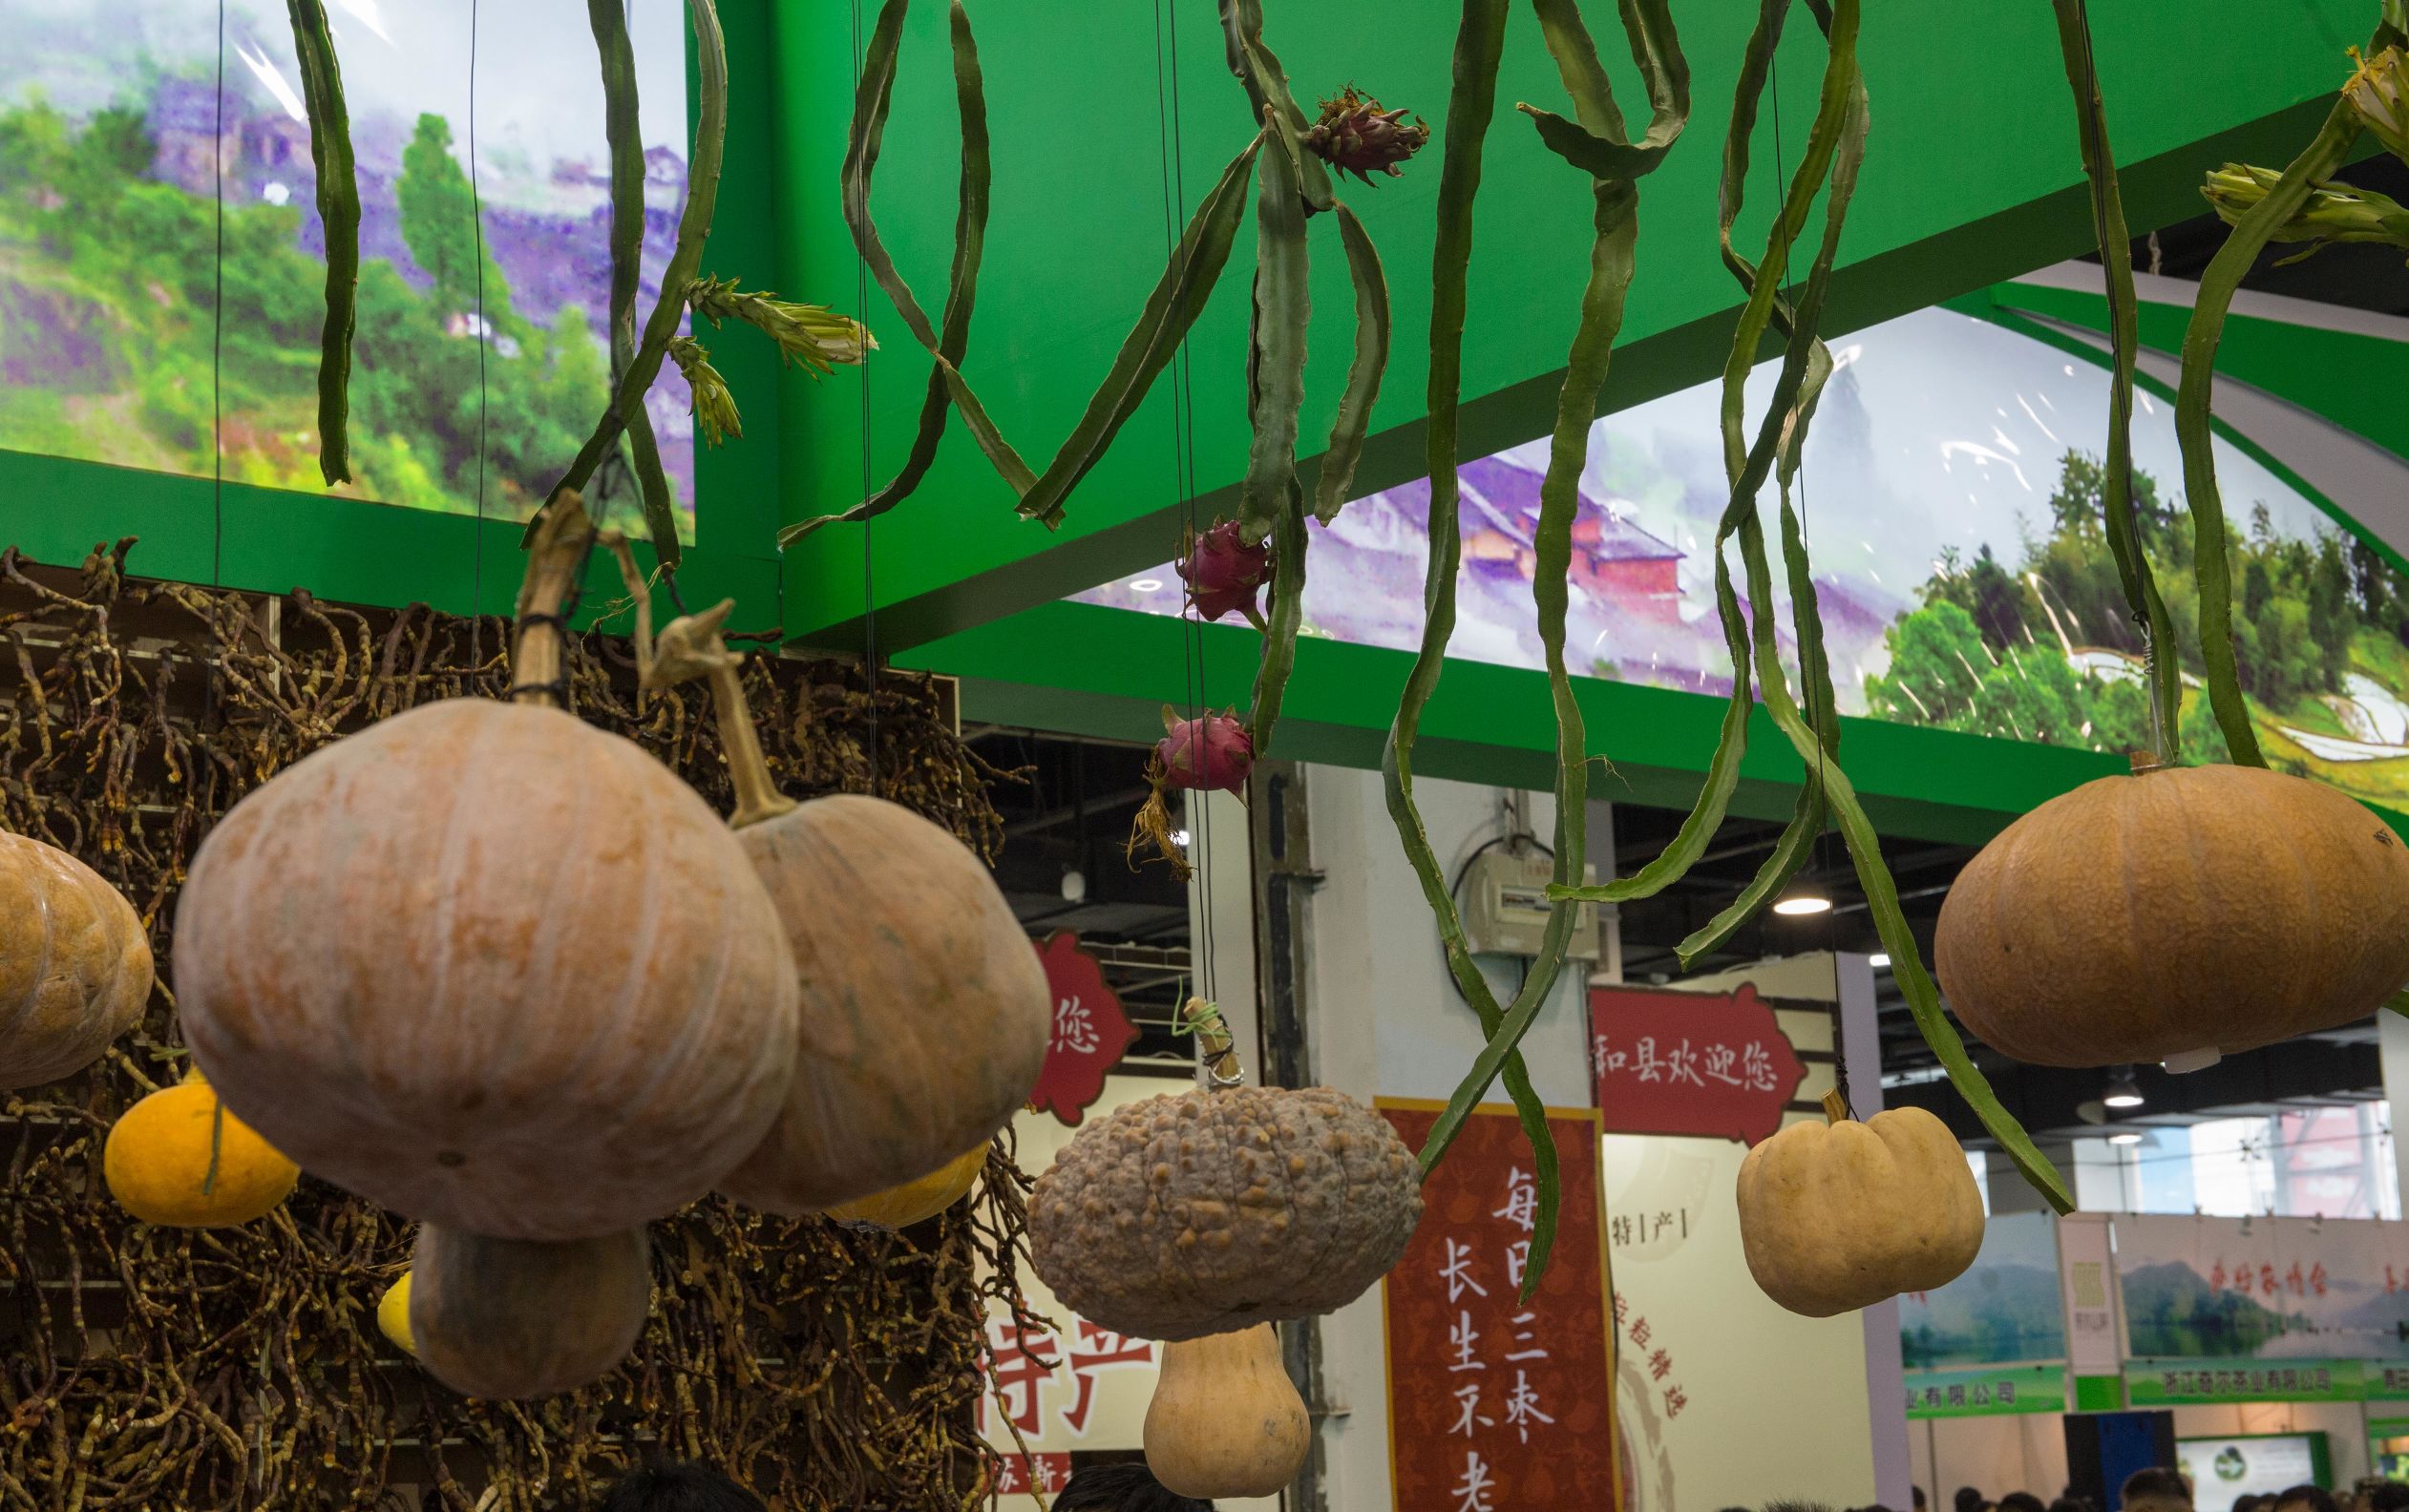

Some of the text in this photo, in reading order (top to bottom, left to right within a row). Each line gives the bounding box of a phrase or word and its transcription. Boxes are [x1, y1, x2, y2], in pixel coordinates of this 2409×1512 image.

[1047, 996, 1100, 1053] 您
[1595, 1035, 1778, 1091] 和县欢迎您
[1439, 1238, 1495, 1512] 长生不老
[1492, 1166, 1554, 1443] 每日三枣
